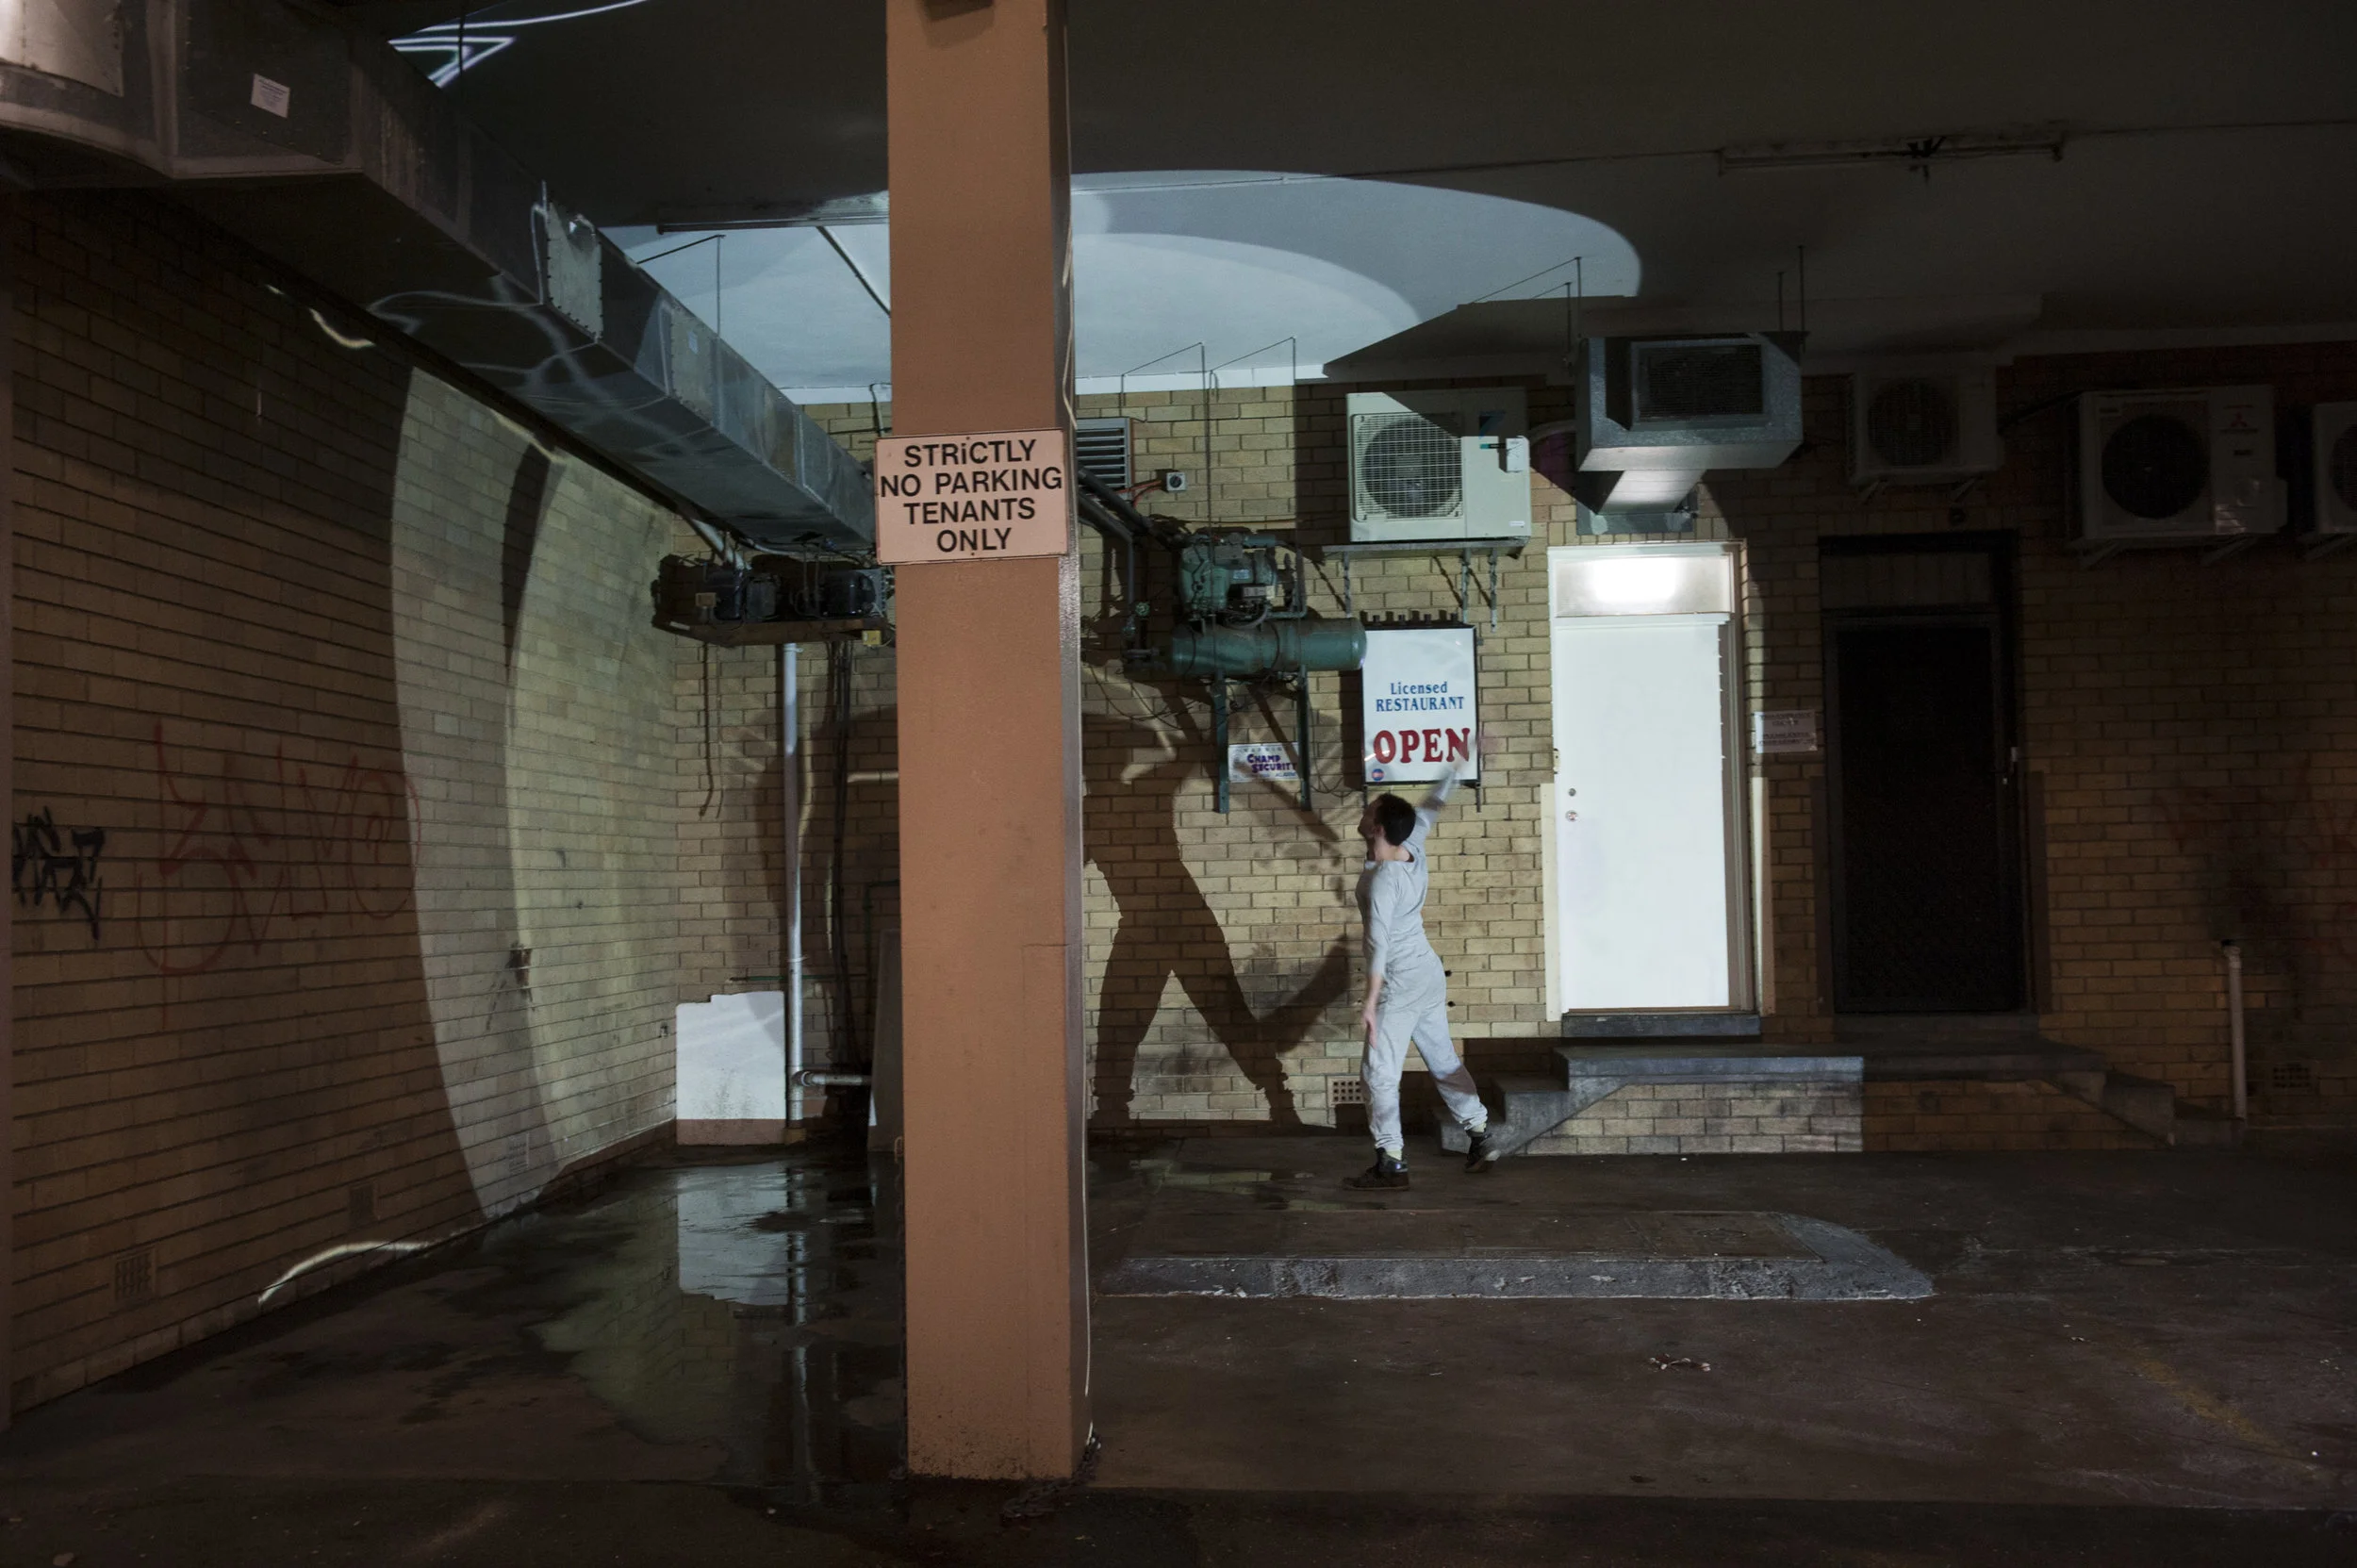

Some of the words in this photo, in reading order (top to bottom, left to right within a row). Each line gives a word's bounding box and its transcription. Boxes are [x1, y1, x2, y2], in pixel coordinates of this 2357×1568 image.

[881, 473, 921, 497] NO
[935, 466, 1062, 494] PARKING
[903, 497, 1035, 524] TENANTS
[937, 527, 1012, 553] ONLY
[1391, 682, 1447, 695] Licensed
[1376, 697, 1464, 712] RESTAURANT
[1246, 753, 1281, 764] CHAMP
[1373, 728, 1470, 764] OPEN
